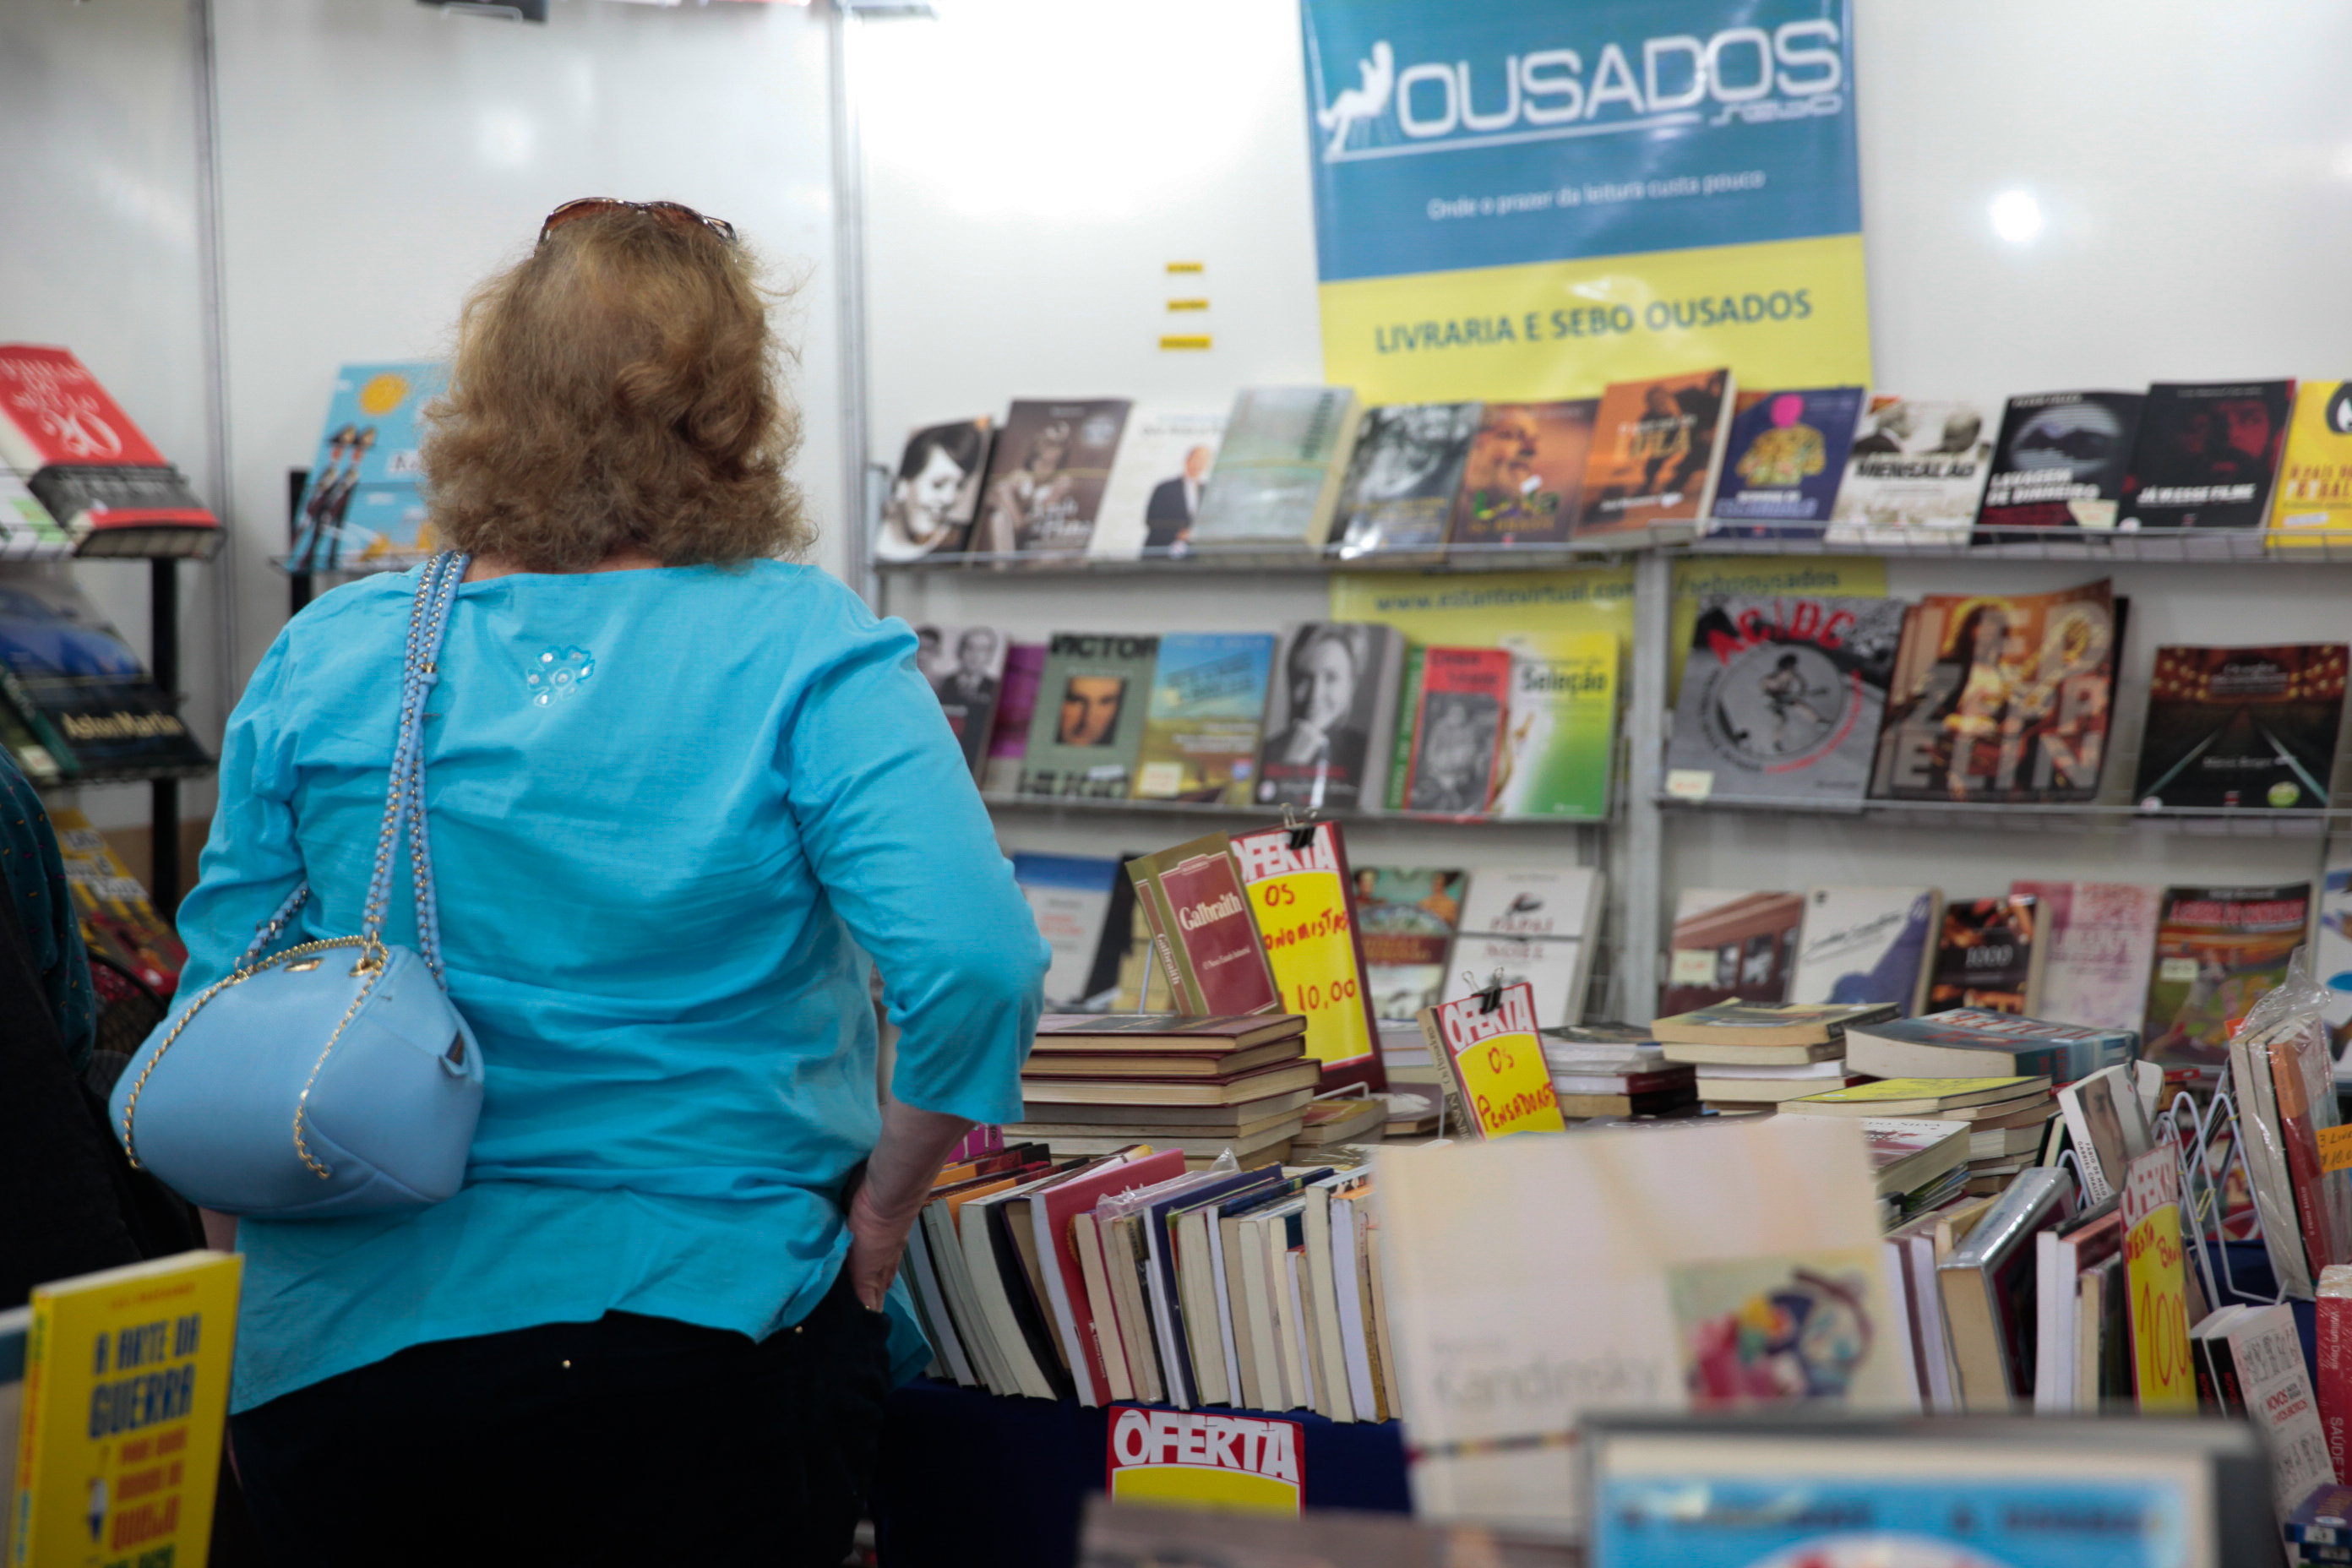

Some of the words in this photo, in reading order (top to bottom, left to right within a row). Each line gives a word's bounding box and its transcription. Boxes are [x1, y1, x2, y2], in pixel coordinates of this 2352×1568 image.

[1396, 19, 1842, 139] OUSADOS
[1427, 194, 1478, 220] Onde
[1479, 196, 1494, 216] o
[1496, 189, 1553, 217] prazer
[1555, 184, 1582, 210] da
[1582, 181, 1646, 206] leitura
[1647, 176, 1701, 200] custa
[1701, 170, 1767, 197] pouco
[1375, 313, 1516, 355] LIVRARIA
[1524, 312, 1542, 340] E
[1549, 304, 1635, 340] SEBO
[1643, 288, 1813, 330] OUSADOS
[1179, 891, 1244, 931] Galbraith
[1157, 933, 1181, 985] Galbraith
[2077, 1141, 2091, 1170] GABRIEL
[94, 1331, 111, 1375] A
[117, 1320, 171, 1371] ARTE
[2330, 1310, 2341, 1343] William
[2330, 1344, 2341, 1370] Davis
[88, 1362, 197, 1440] GUERRA
[1113, 1409, 1299, 1483] OFERTA
[2329, 1417, 2346, 1467] SAÚDE
